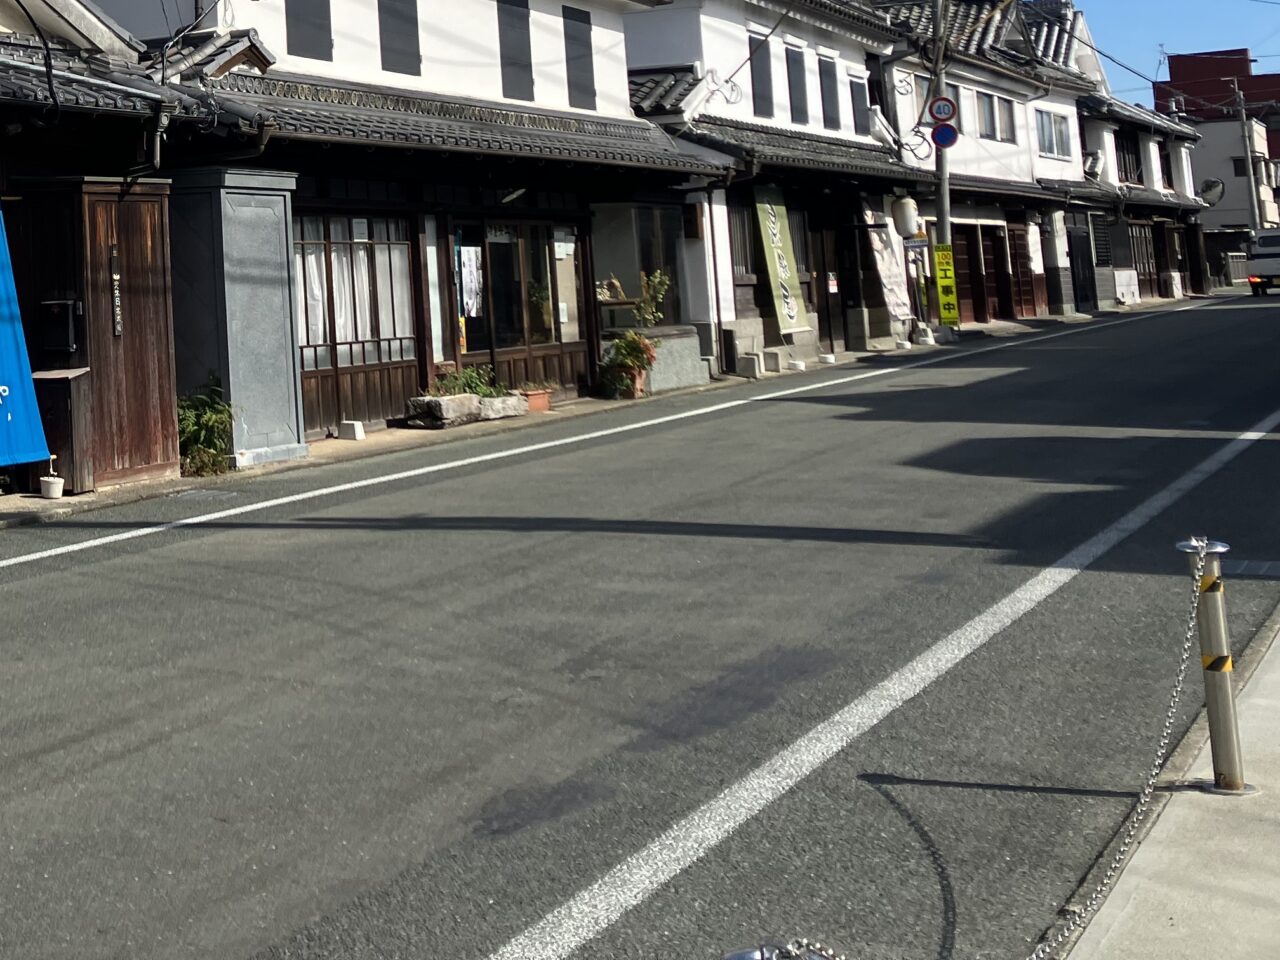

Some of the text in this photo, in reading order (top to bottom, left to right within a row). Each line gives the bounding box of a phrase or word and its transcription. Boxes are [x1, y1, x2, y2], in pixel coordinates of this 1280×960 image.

[935, 104, 951, 115] 40
[939, 268, 956, 314] 工事中
